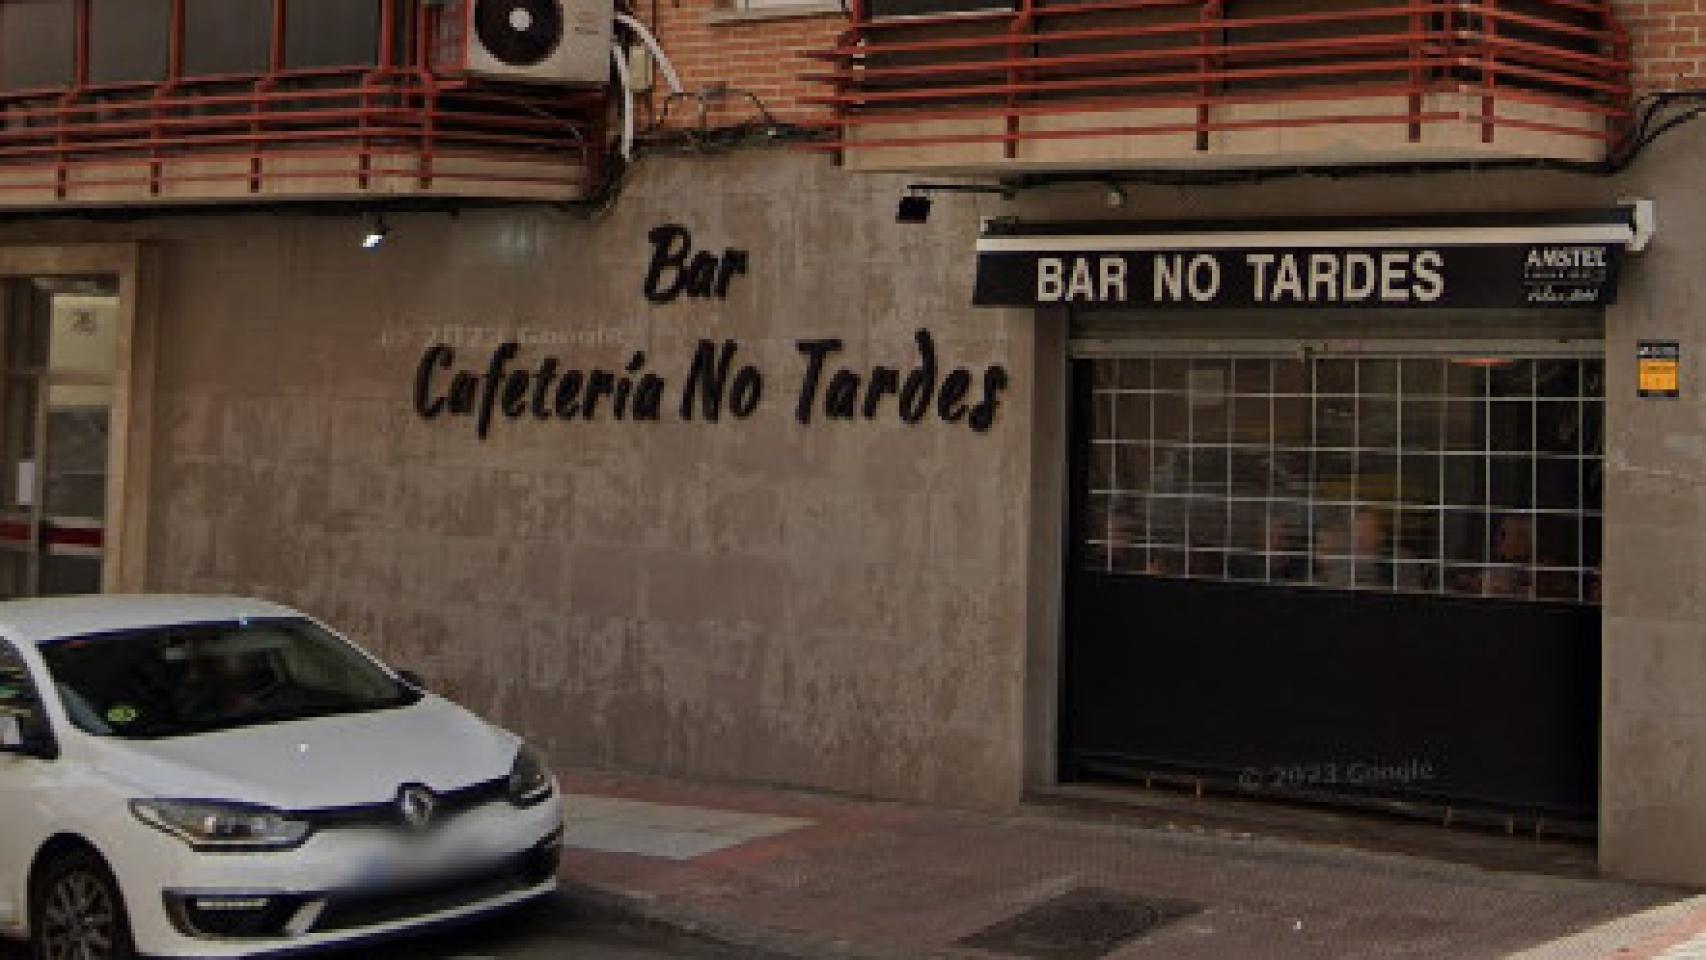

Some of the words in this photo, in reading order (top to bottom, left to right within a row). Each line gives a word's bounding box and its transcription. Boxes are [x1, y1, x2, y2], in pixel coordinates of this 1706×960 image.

[644, 225, 748, 302] Bar
[1036, 256, 1127, 301] BAR
[1154, 254, 1220, 301] NO
[1247, 251, 1443, 301] TARDES
[413, 343, 664, 440] Cafetería
[679, 339, 764, 424] No
[795, 328, 1008, 432] Tardes
